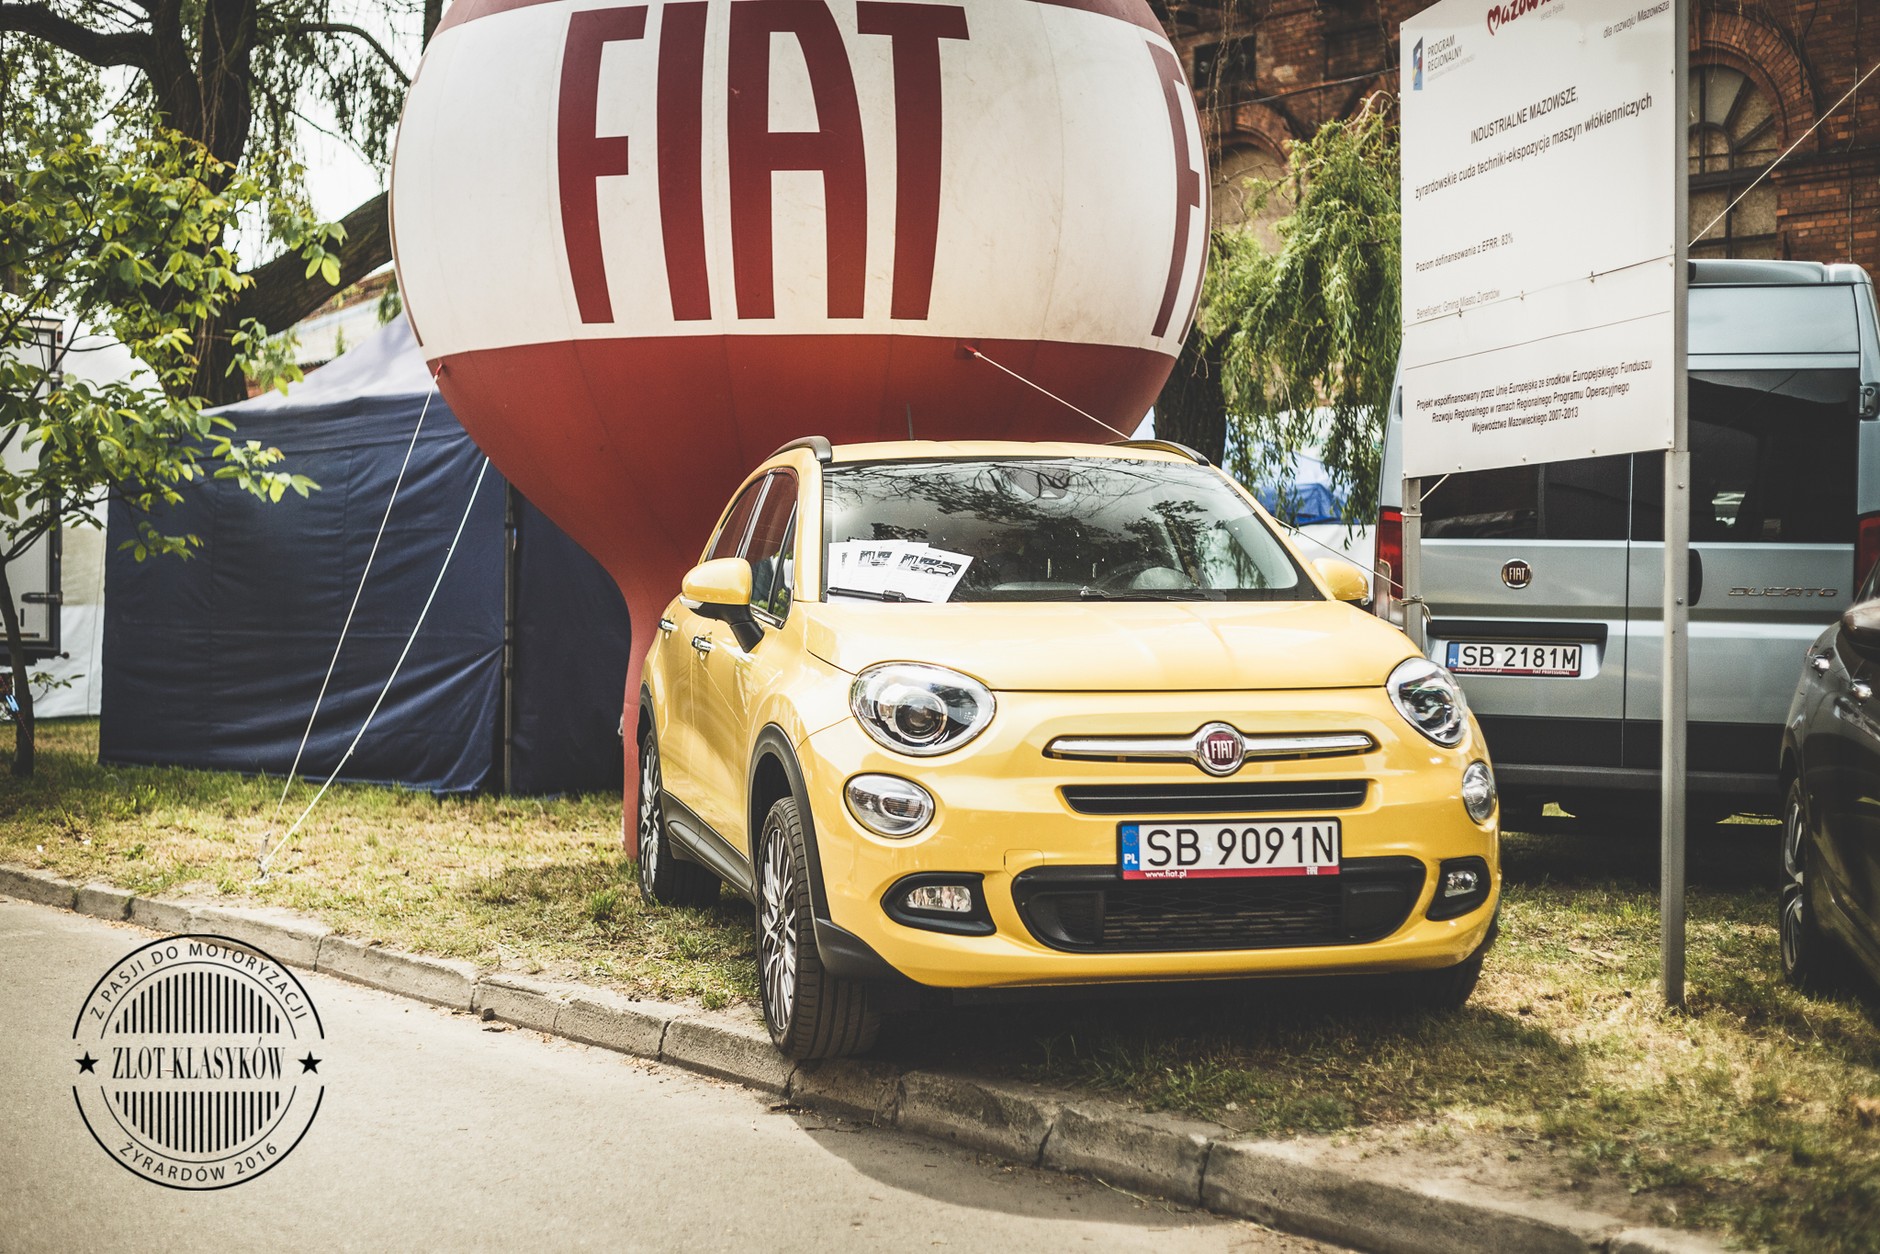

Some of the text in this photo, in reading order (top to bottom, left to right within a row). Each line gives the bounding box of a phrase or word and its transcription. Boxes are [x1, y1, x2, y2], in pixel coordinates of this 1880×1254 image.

[1603, 0, 1670, 38] dla rozwoju Mazowsza
[1427, 34, 1455, 58] PROGRAM
[1427, 44, 1463, 72] REGIONALNY
[1471, 86, 1579, 144] INDUSTRIALNE MAZOWSZE,
[1415, 92, 1653, 201] żyrardowskie cuda techniki-ekspozycja maszyn włókienniczych
[557, 0, 970, 324] FIAT
[1416, 260, 1434, 273] Poziom
[1435, 246, 1477, 267] dofinansowania
[1443, 299, 1459, 312] Gmina
[1460, 295, 1476, 307] Miasto
[1477, 289, 1501, 304] Żyrardów
[1416, 359, 1653, 411] Projekt współfinansowany przez Unię Europejską ze środków Europejskiego Funduszu
[1432, 411, 1453, 423] Rozwoju
[1454, 406, 1489, 421] Regionalnego
[1495, 400, 1515, 413] ramach
[1516, 394, 1552, 410] Regionalnego
[1553, 390, 1583, 404] Programu
[1585, 382, 1630, 399] Operacyjnego
[1471, 406, 1579, 434] Województwa Mazowieckiego 2007-2013
[1509, 567, 1526, 580] FIAT
[1728, 587, 1838, 598] DUCATO
[1462, 646, 1494, 667] SB
[1503, 646, 1577, 669] 2181M
[1210, 740, 1234, 759] FIAT
[1124, 826, 1333, 867] PL SB 9091N
[1145, 869, 1187, 879] www.fiat.pl
